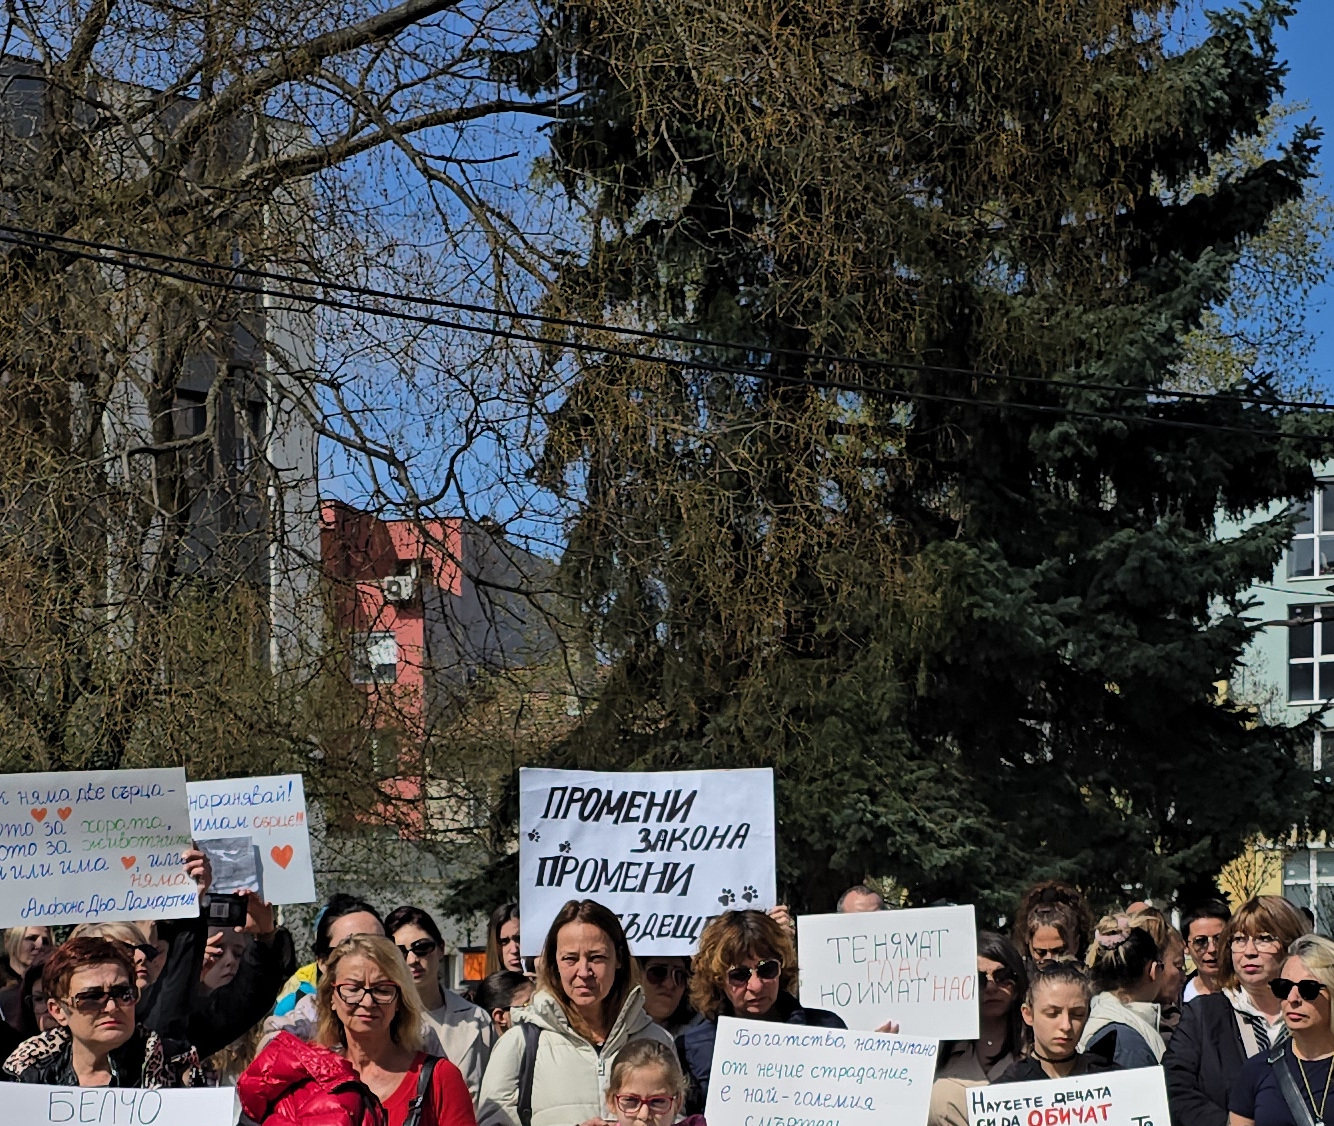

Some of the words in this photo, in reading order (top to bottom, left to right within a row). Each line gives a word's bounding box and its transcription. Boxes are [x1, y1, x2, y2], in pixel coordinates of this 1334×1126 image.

[17, 788, 72, 806] няма
[540, 786, 698, 825] ПРОМЕНИ
[43, 820, 67, 837] за
[193, 815, 249, 831] имам
[45, 840, 71, 855] за
[630, 822, 750, 853] ЗАКОНА
[11, 863, 54, 880] или
[60, 857, 109, 874] има
[535, 854, 695, 897] ПРОМЕНИ
[826, 935, 868, 964] ТЕ
[873, 929, 950, 961] НЯМАТ
[866, 956, 930, 983] ГЛАС
[820, 982, 852, 1007] НО
[858, 978, 927, 1005] ИМАТ
[721, 1060, 748, 1076] от
[756, 1062, 805, 1079] нечие
[49, 1090, 163, 1125] БЕЛЧО
